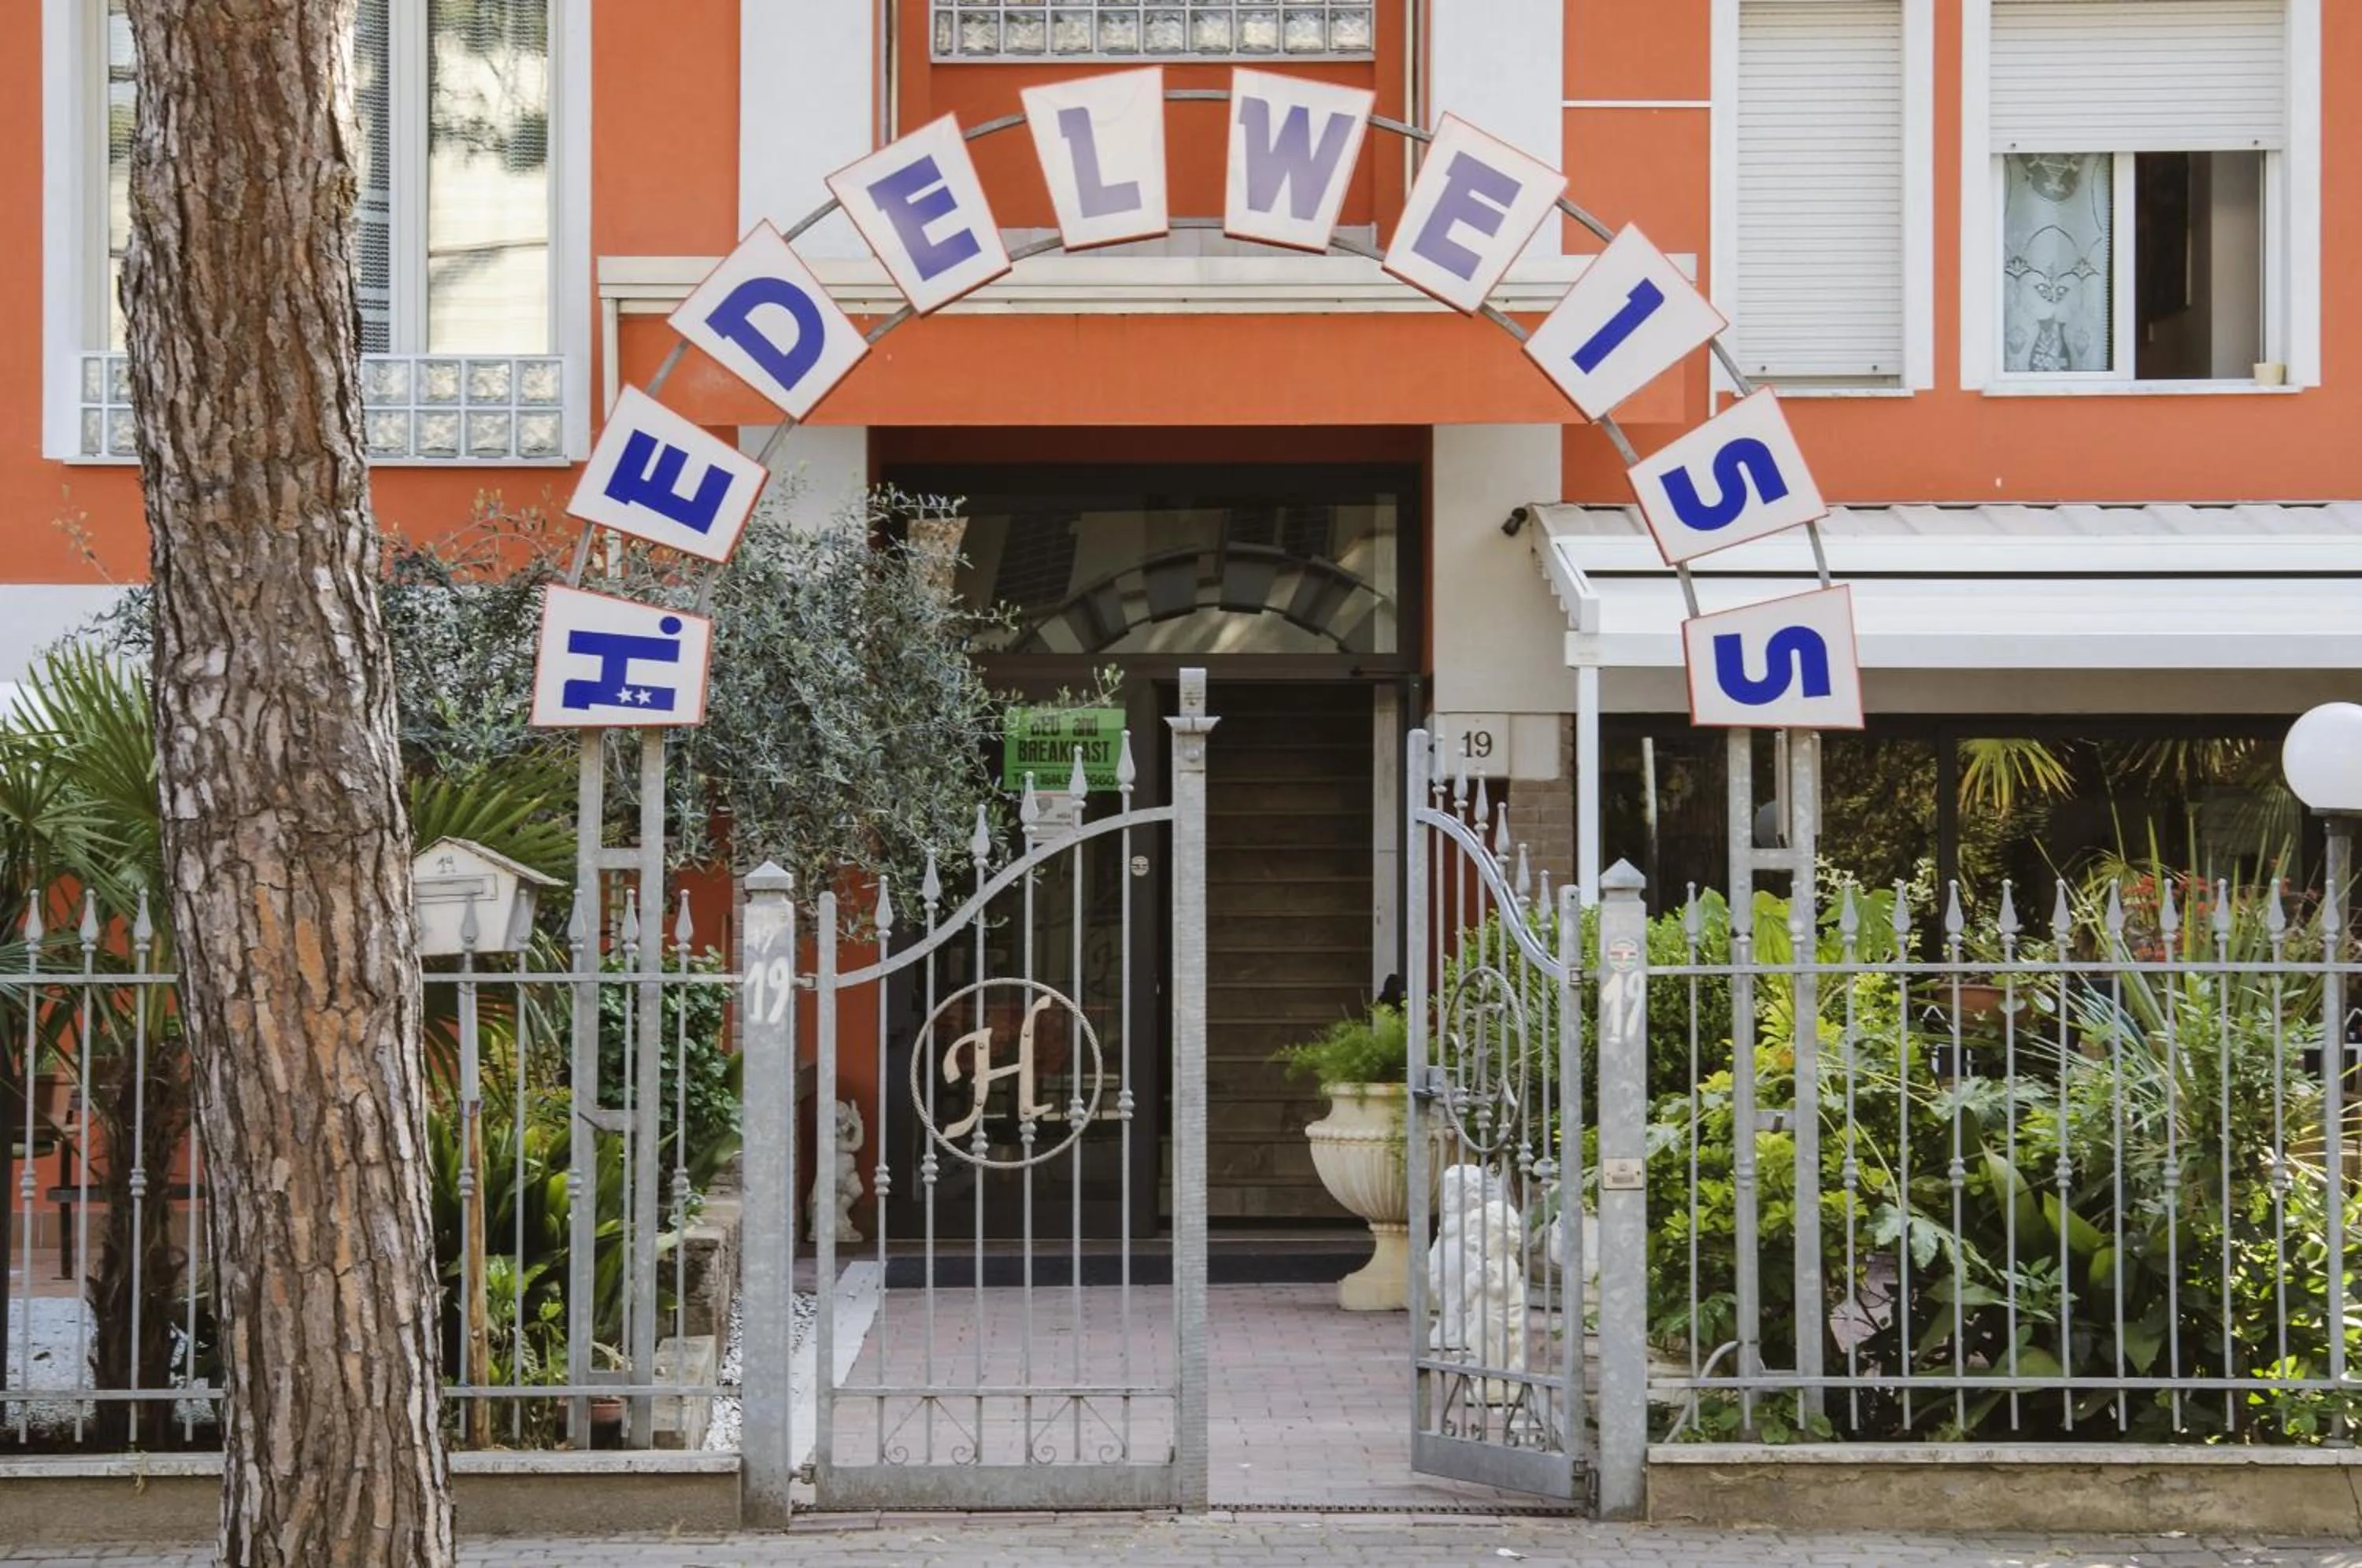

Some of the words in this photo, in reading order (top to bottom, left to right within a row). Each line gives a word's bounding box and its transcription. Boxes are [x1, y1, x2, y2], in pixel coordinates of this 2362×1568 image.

[1461, 730, 1493, 758] 19
[745, 956, 790, 1023] 19
[1602, 971, 1643, 1043] 19
